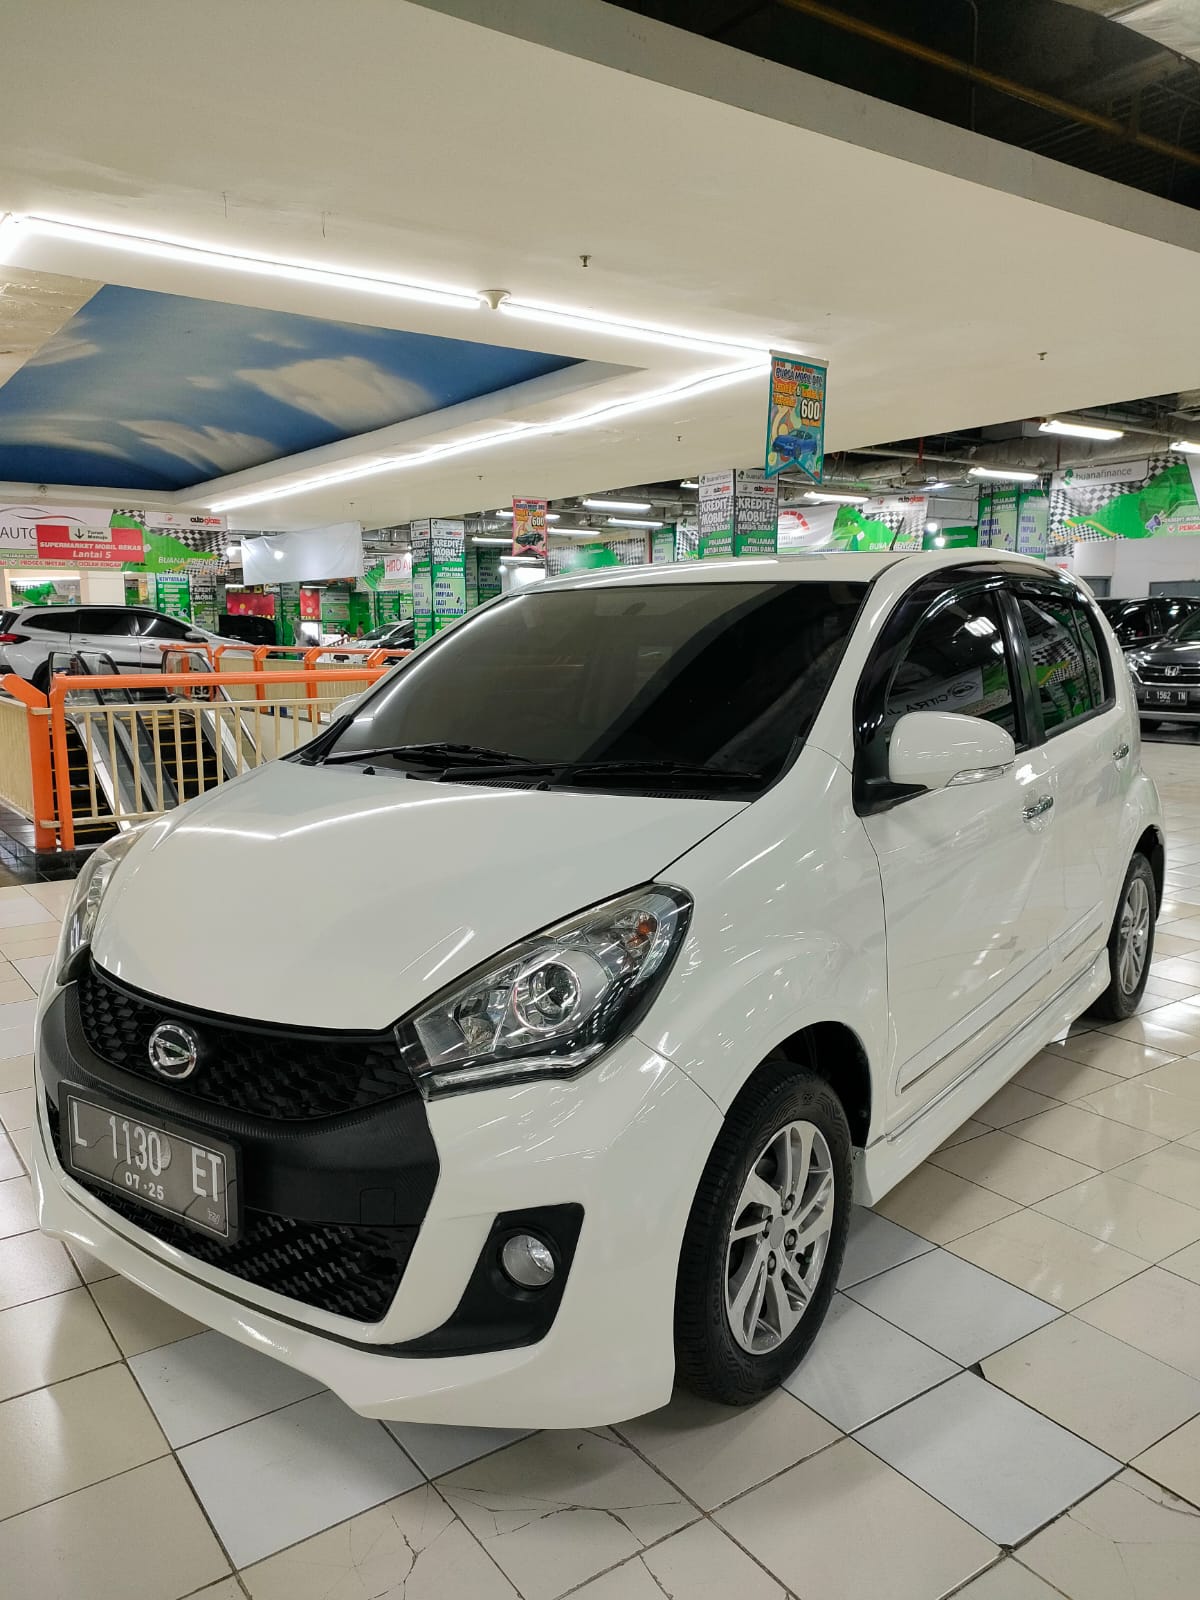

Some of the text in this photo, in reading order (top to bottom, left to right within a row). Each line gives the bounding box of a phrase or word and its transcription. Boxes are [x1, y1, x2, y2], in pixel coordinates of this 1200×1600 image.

[801, 399, 820, 420] 600
[1076, 467, 1132, 479] buanafinance
[701, 498, 728, 513] KREDIT
[738, 497, 771, 510] KREDIT
[532, 517, 544, 526] 600
[701, 511, 725, 526] MOBIL
[738, 510, 767, 522] MOBIL
[40, 542, 93, 550] SUPERMARKET
[434, 540, 460, 548] KREDIT
[72, 550, 112, 559] Lantai 5
[1146, 690, 1150, 699] L
[73, 1101, 222, 1202] L 1130 ET
